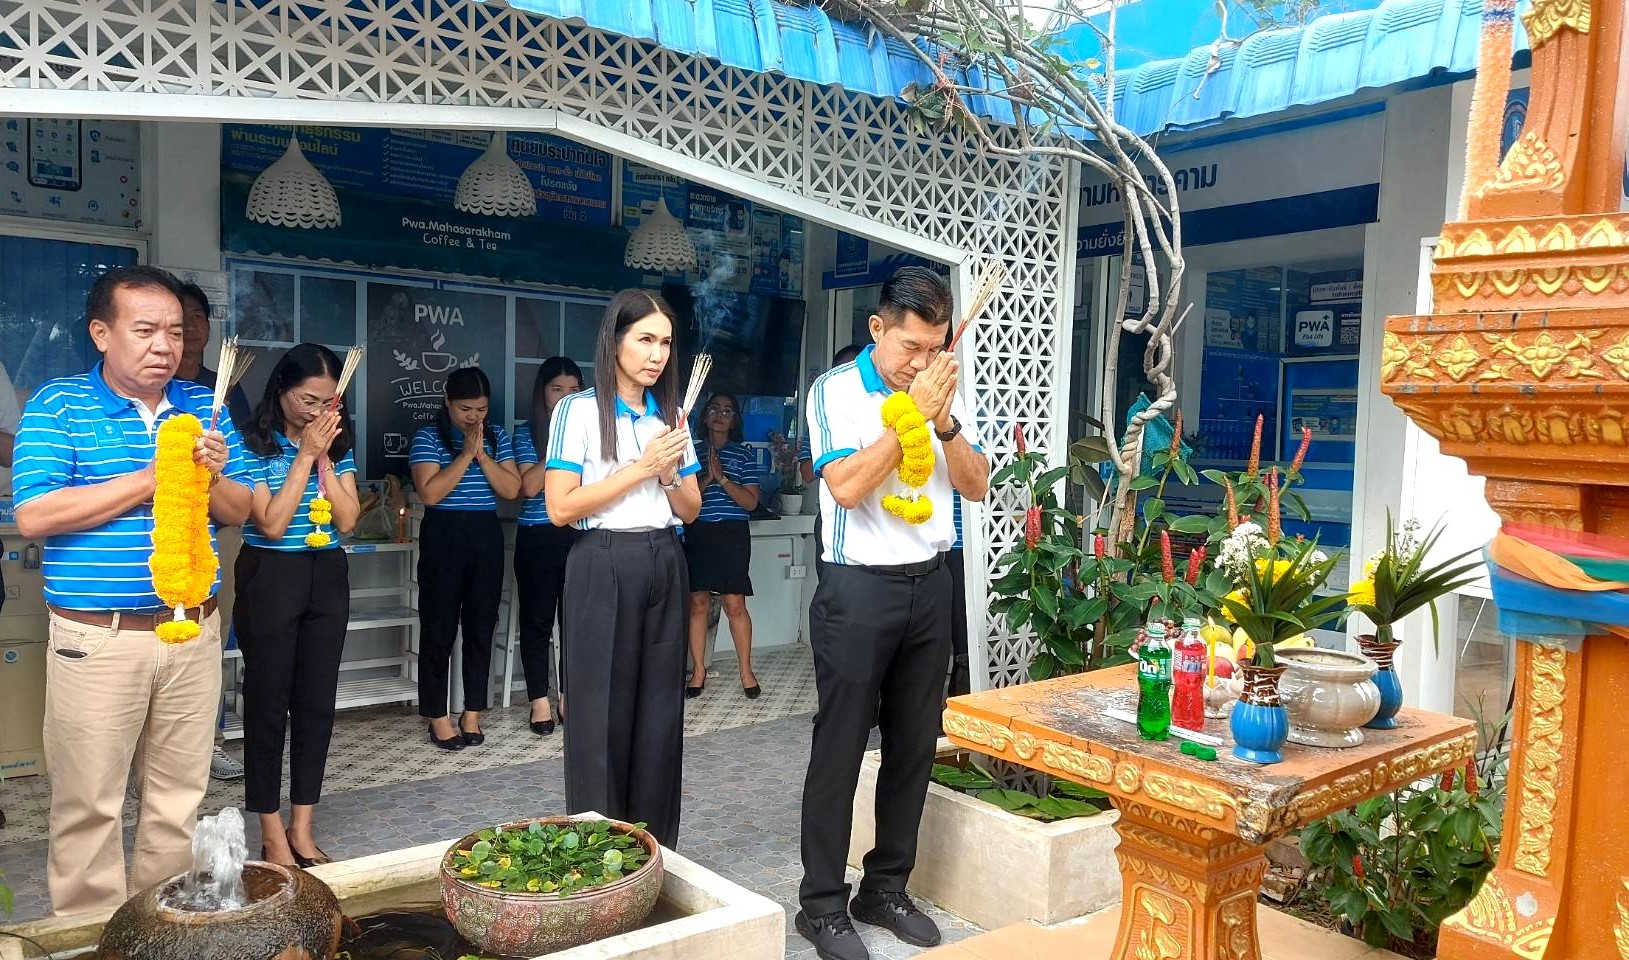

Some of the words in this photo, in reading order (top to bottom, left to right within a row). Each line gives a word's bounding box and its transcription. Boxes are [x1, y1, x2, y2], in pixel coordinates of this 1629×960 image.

[231, 129, 339, 156] ผ่านระบบอนไลน์
[401, 217, 512, 241] Pwa.Mahasarakham
[423, 233, 461, 247] Coffee
[466, 237, 475, 249] &
[478, 238, 498, 251] Tea
[414, 303, 465, 327] PWA
